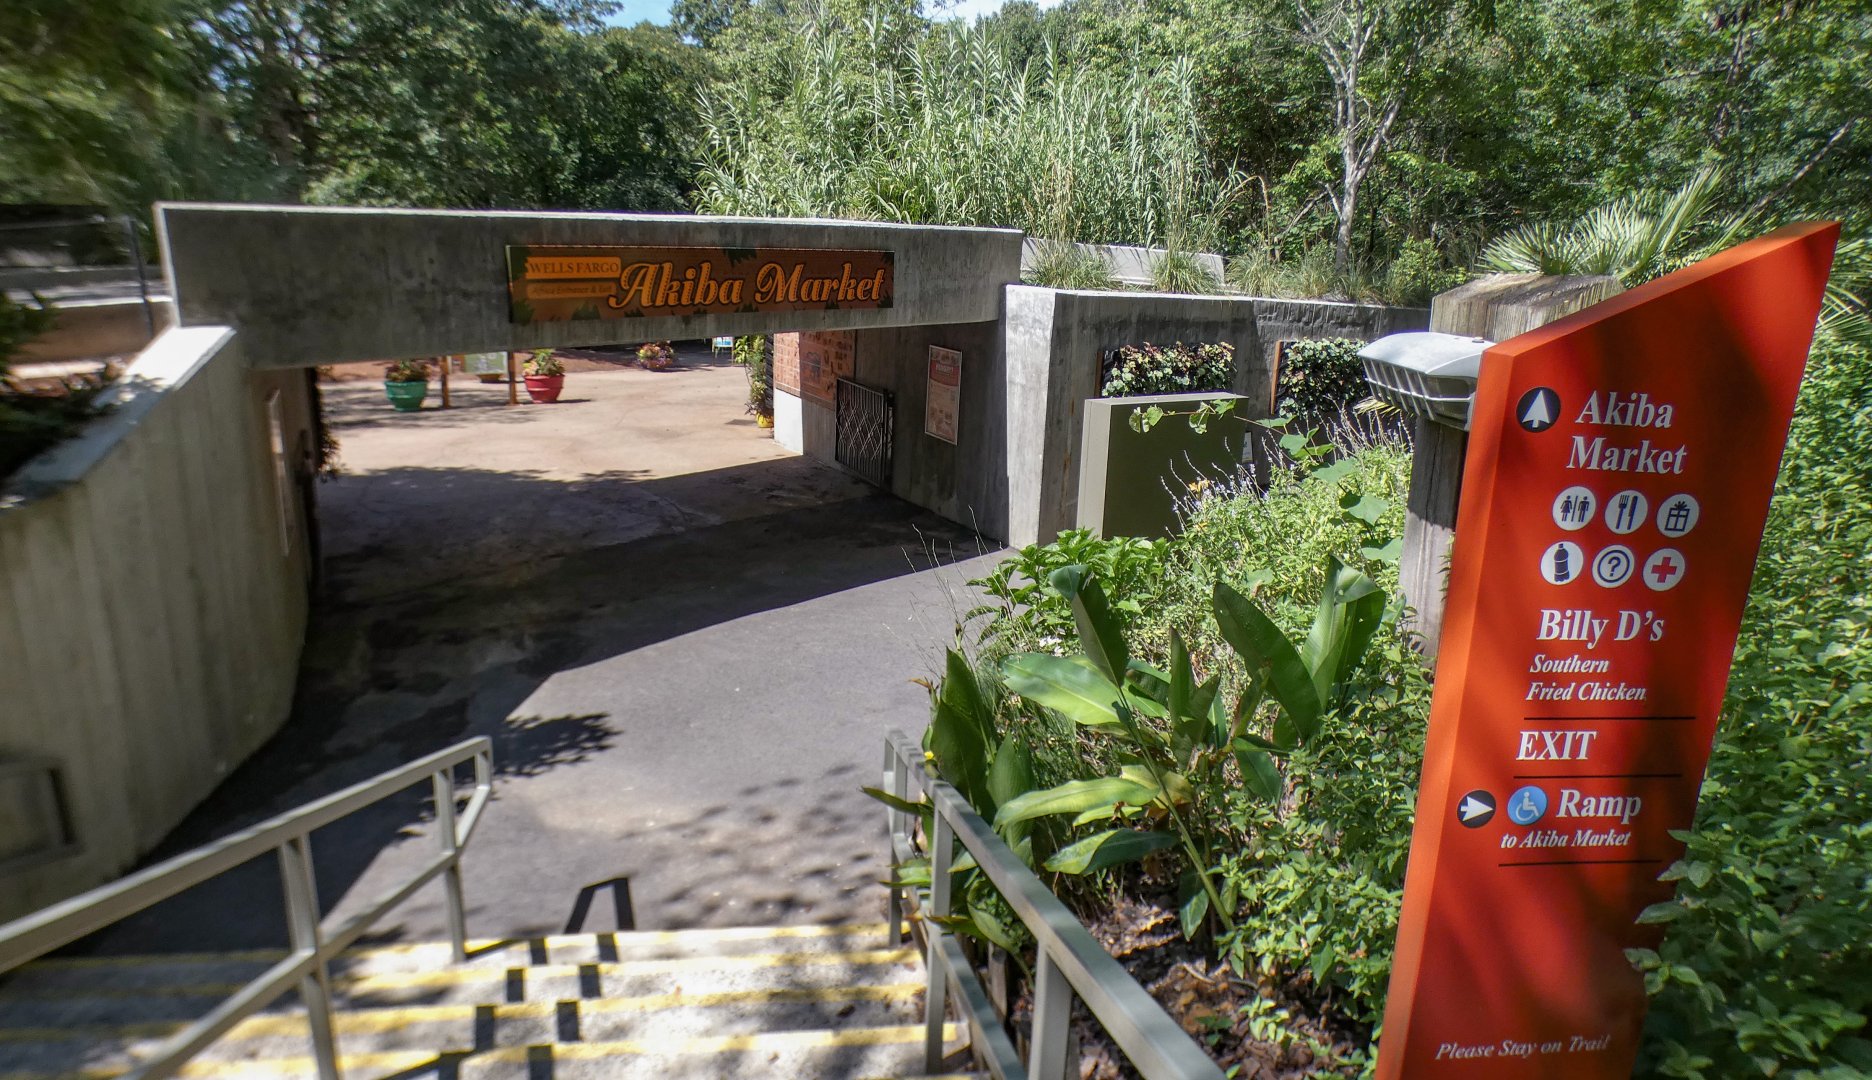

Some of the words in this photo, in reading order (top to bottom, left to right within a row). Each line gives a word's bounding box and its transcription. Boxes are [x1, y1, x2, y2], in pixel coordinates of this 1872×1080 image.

[529, 262, 574, 274] WELLS
[576, 262, 619, 273] FARGO
[609, 262, 744, 309] Akiba
[756, 262, 885, 303] Market
[1575, 390, 1674, 429] Akiba
[1566, 435, 1688, 475] Market
[1536, 609, 1610, 650] Billy
[1614, 610, 1665, 642] D’s
[1529, 654, 1610, 673] Southern
[1525, 682, 1576, 701] Fried
[1577, 682, 1647, 701] Chicken
[1516, 731, 1597, 760] EXIT
[1556, 789, 1642, 824] Ramp
[1501, 833, 1518, 849] to
[1519, 831, 1568, 849] Akiba
[1571, 829, 1631, 848] Market
[1435, 1042, 1495, 1060] Please
[1497, 1039, 1538, 1059] Stay
[1540, 1041, 1563, 1053] on
[1568, 1034, 1612, 1053] Trail
